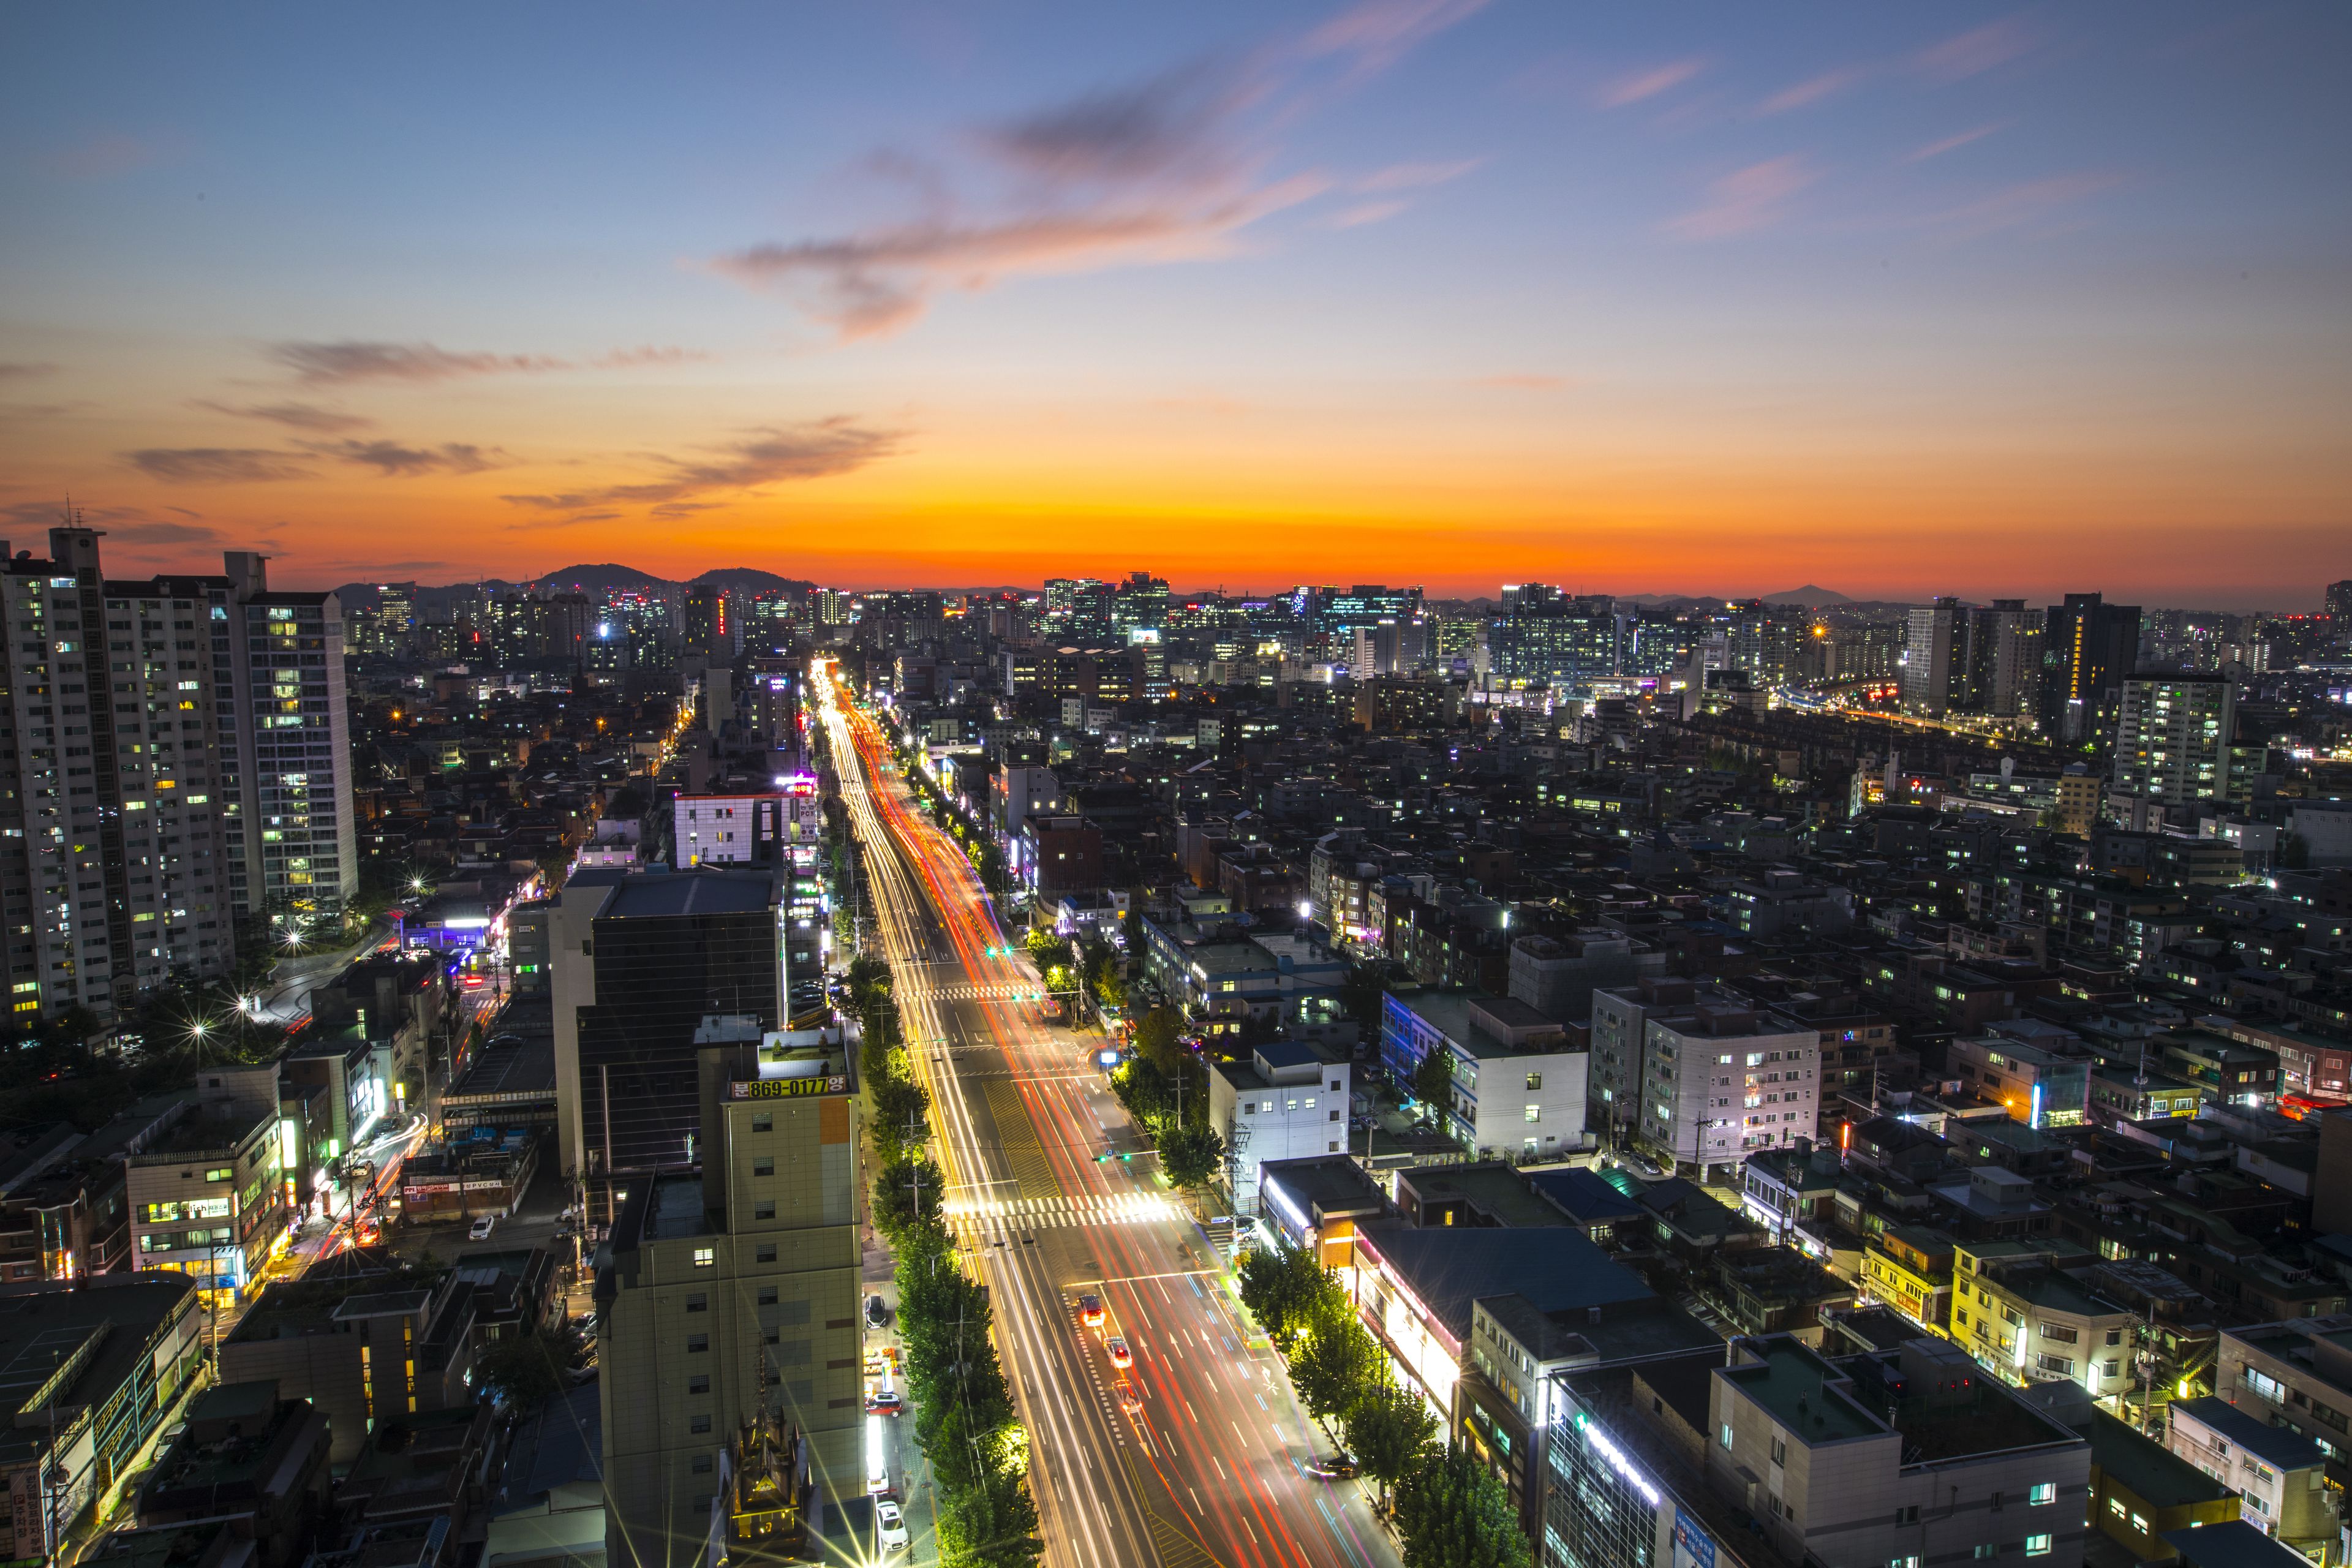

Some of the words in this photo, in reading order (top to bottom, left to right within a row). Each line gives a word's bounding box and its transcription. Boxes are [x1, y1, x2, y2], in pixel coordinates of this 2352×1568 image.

[735, 1084, 748, 1097] 분
[751, 1079, 827, 1097] 869-0177
[829, 1077, 843, 1091] 양
[172, 1204, 206, 1216] English
[15, 1506, 27, 1537] 주차장
